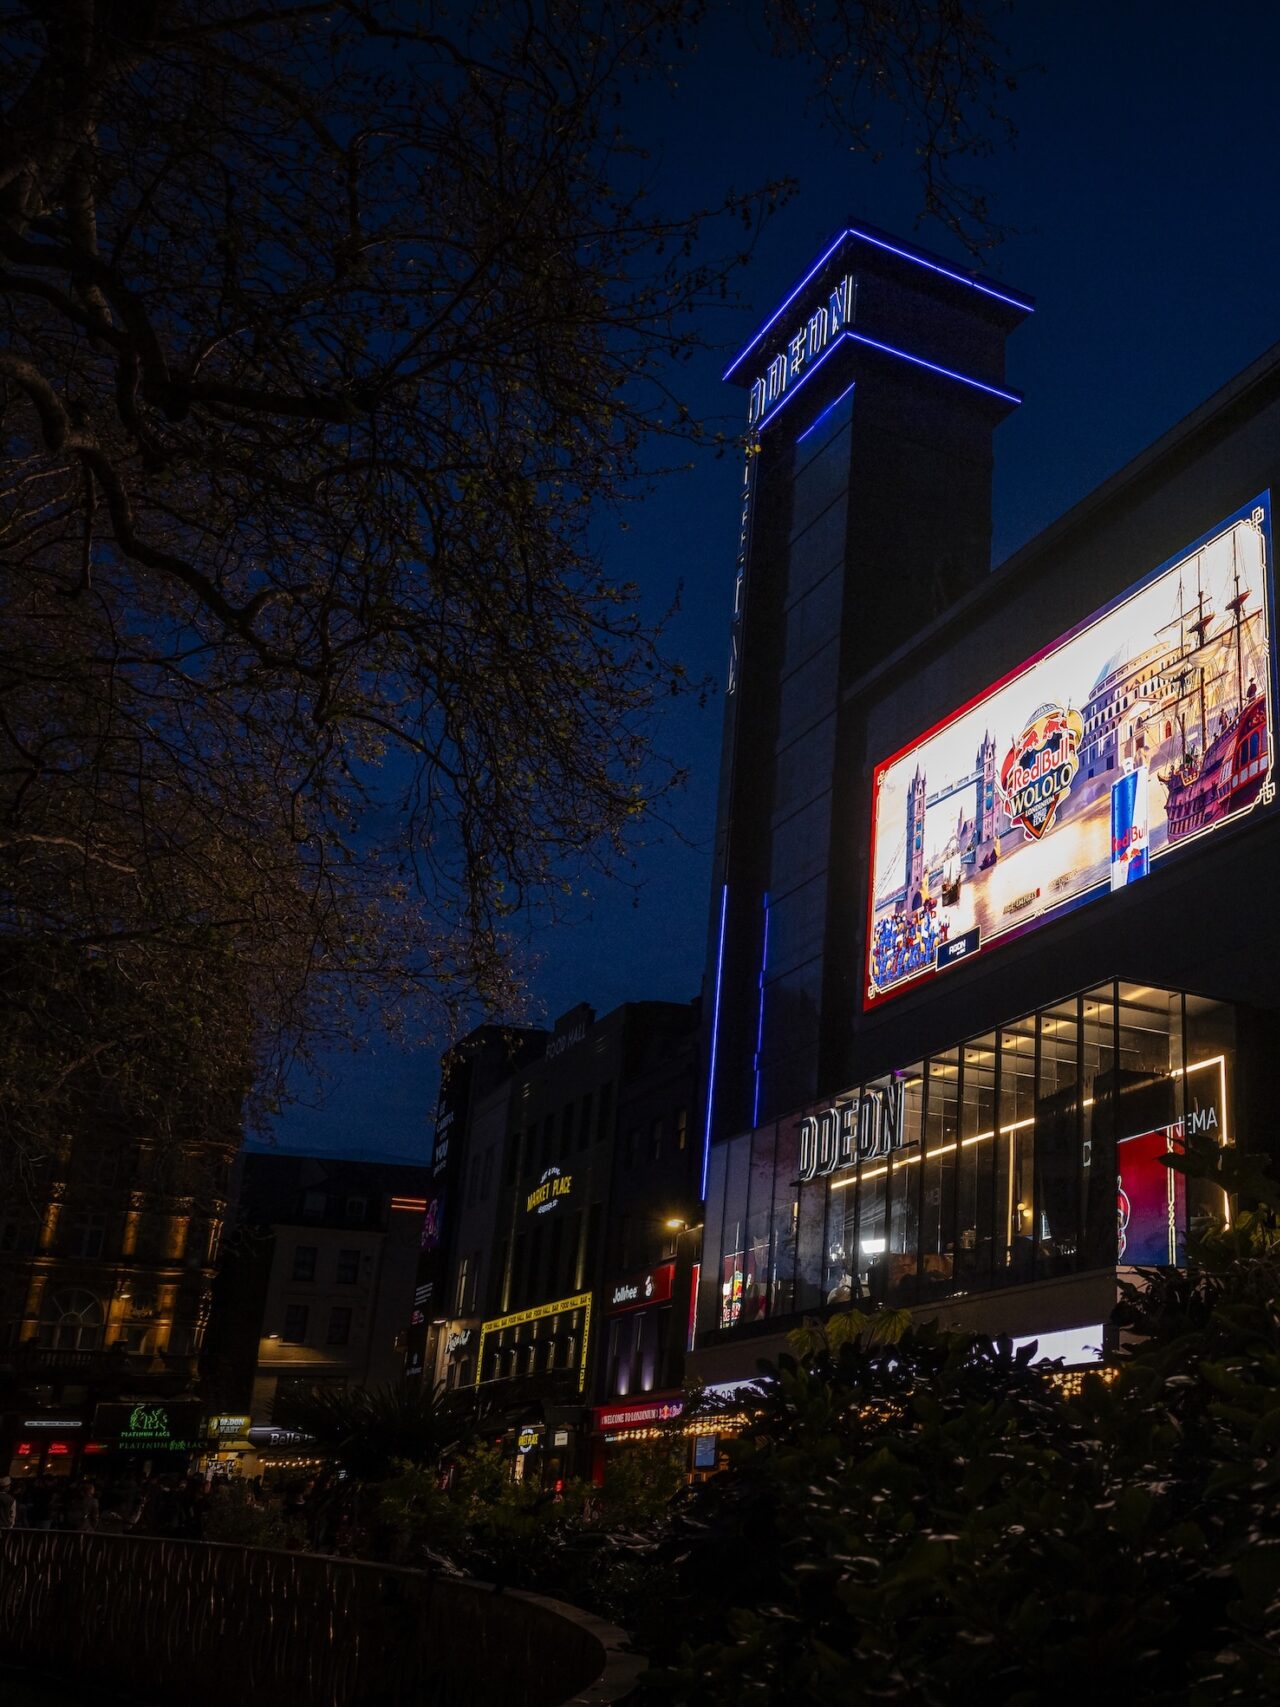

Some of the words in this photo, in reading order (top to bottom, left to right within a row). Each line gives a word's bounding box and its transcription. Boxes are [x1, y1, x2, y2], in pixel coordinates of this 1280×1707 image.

[748, 274, 853, 425] ODEON
[1013, 755, 1040, 791] Red
[1041, 737, 1069, 773] Bull
[1010, 764, 1072, 817] WOLOLO
[799, 1081, 905, 1182] ODEON
[526, 1182, 551, 1213] MARKET
[552, 1176, 572, 1197] PLACE
[612, 1284, 638, 1304] Jollibee
[603, 1412, 624, 1425] WELCOME
[119, 1441, 168, 1449] PLATINUM
[270, 1433, 300, 1446] Bella
